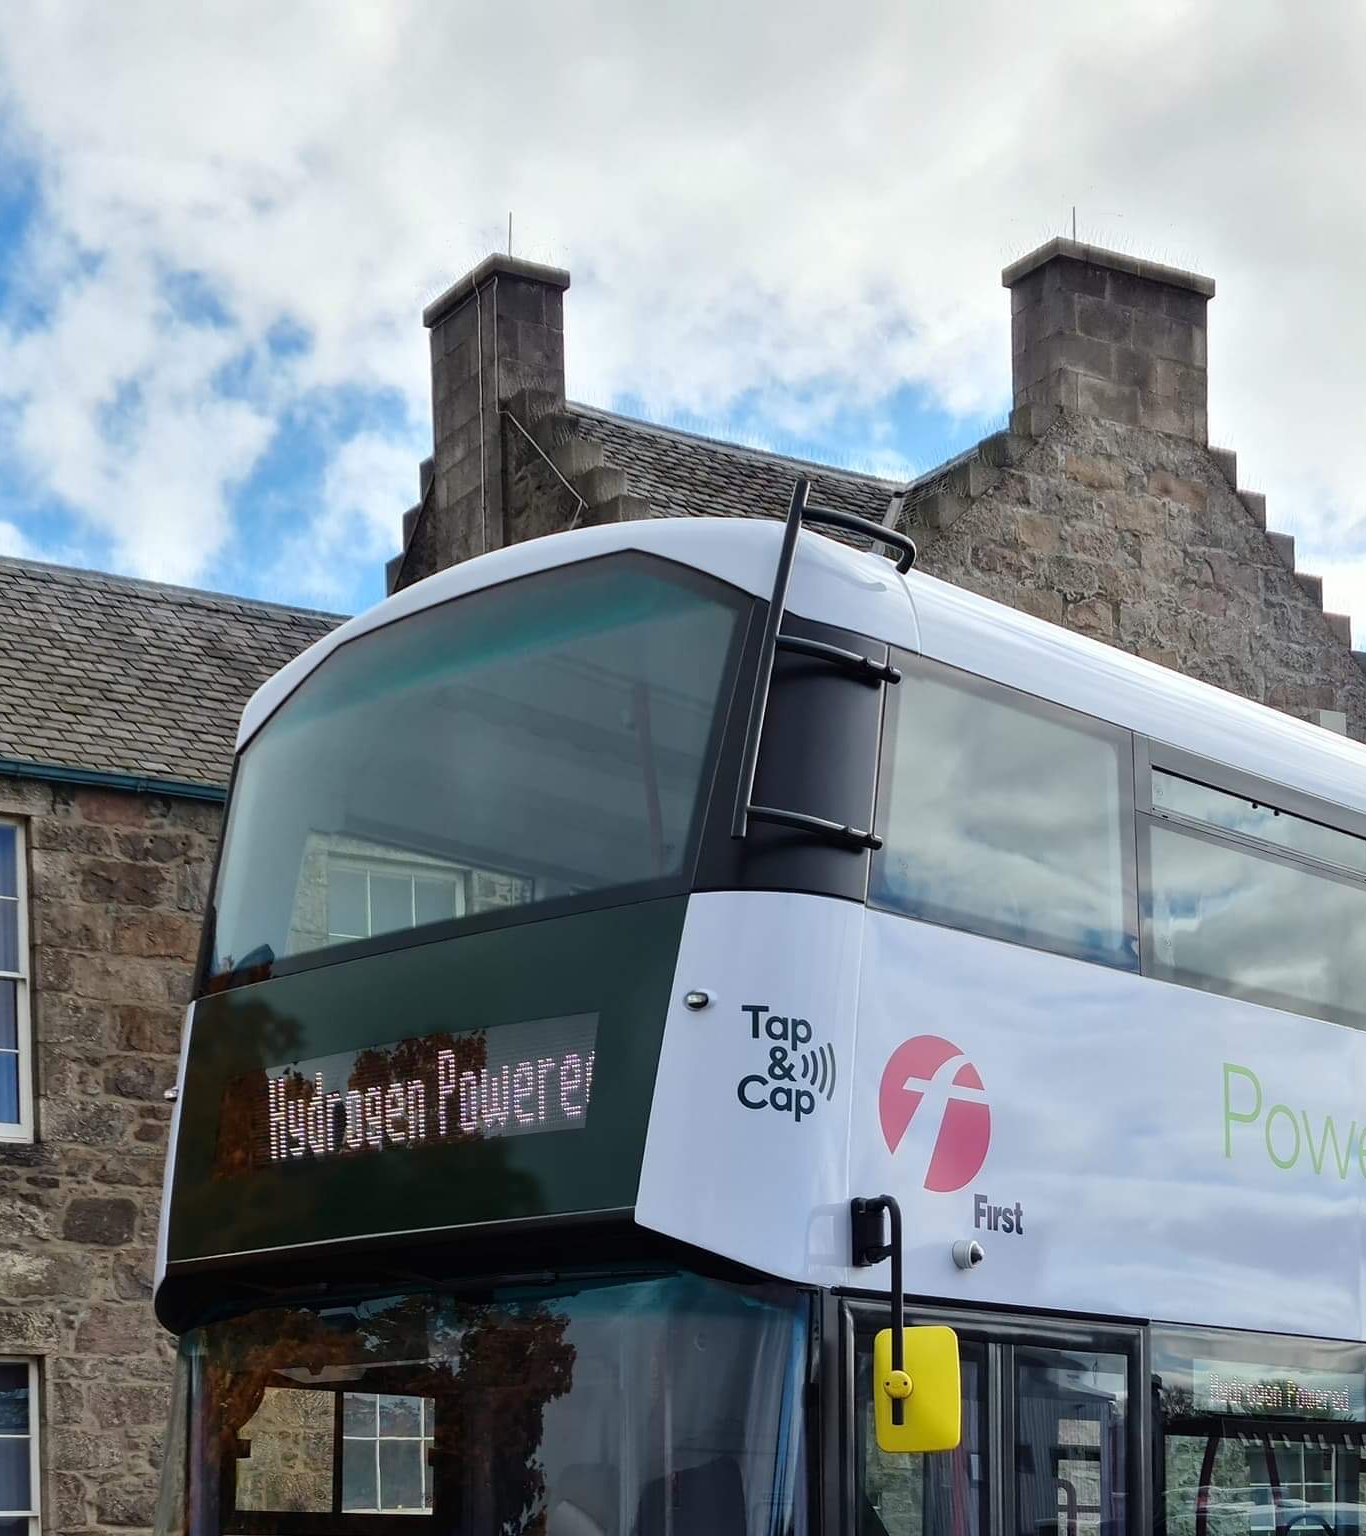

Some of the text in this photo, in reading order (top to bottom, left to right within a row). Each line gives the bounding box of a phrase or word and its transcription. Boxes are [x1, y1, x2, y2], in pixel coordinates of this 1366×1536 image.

[741, 1004, 812, 1051] Tap
[767, 1045, 797, 1082] &
[269, 1072, 425, 1160] Hydrogen
[737, 1075, 815, 1122] Cap
[973, 1193, 1024, 1235] First
